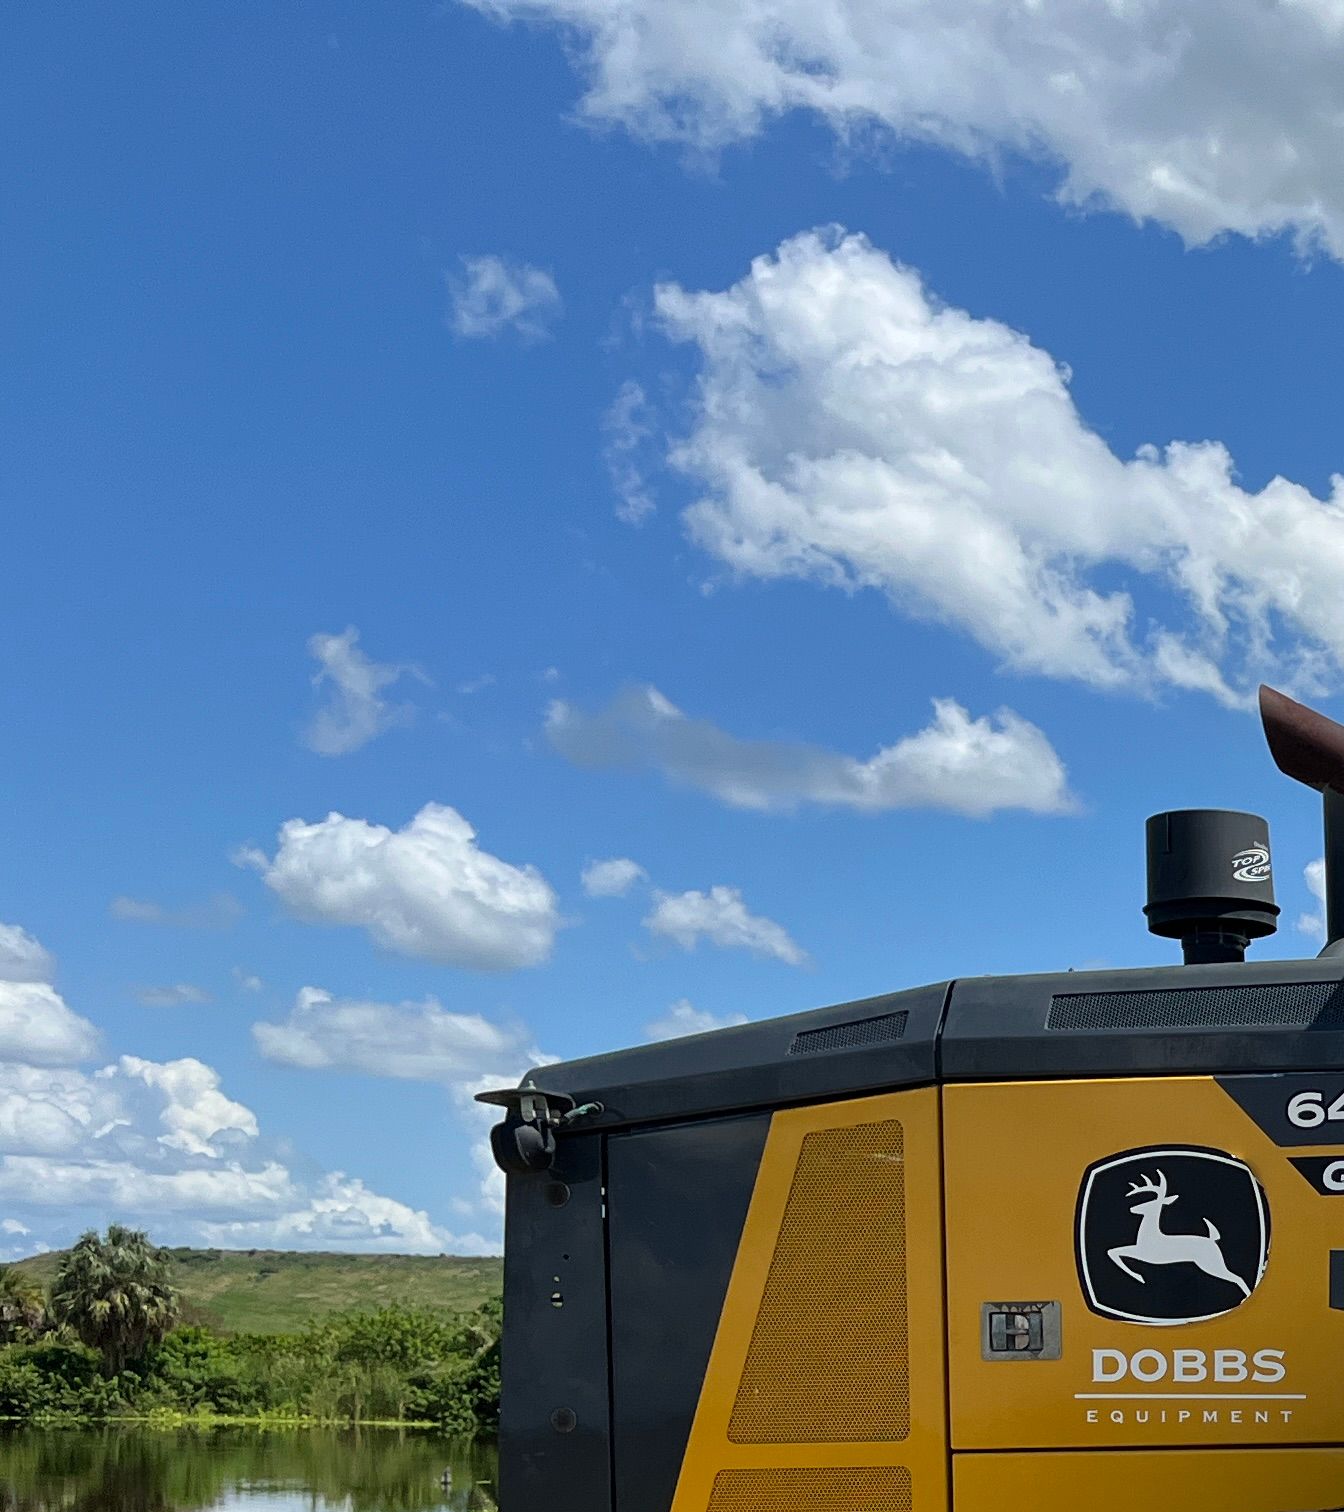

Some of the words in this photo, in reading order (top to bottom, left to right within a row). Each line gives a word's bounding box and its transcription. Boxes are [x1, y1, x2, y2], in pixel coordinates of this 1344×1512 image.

[1231, 855, 1260, 868] TOP
[1091, 1348, 1287, 1383] DOBBS
[1085, 1409, 1294, 1424] EQUIPMENT
